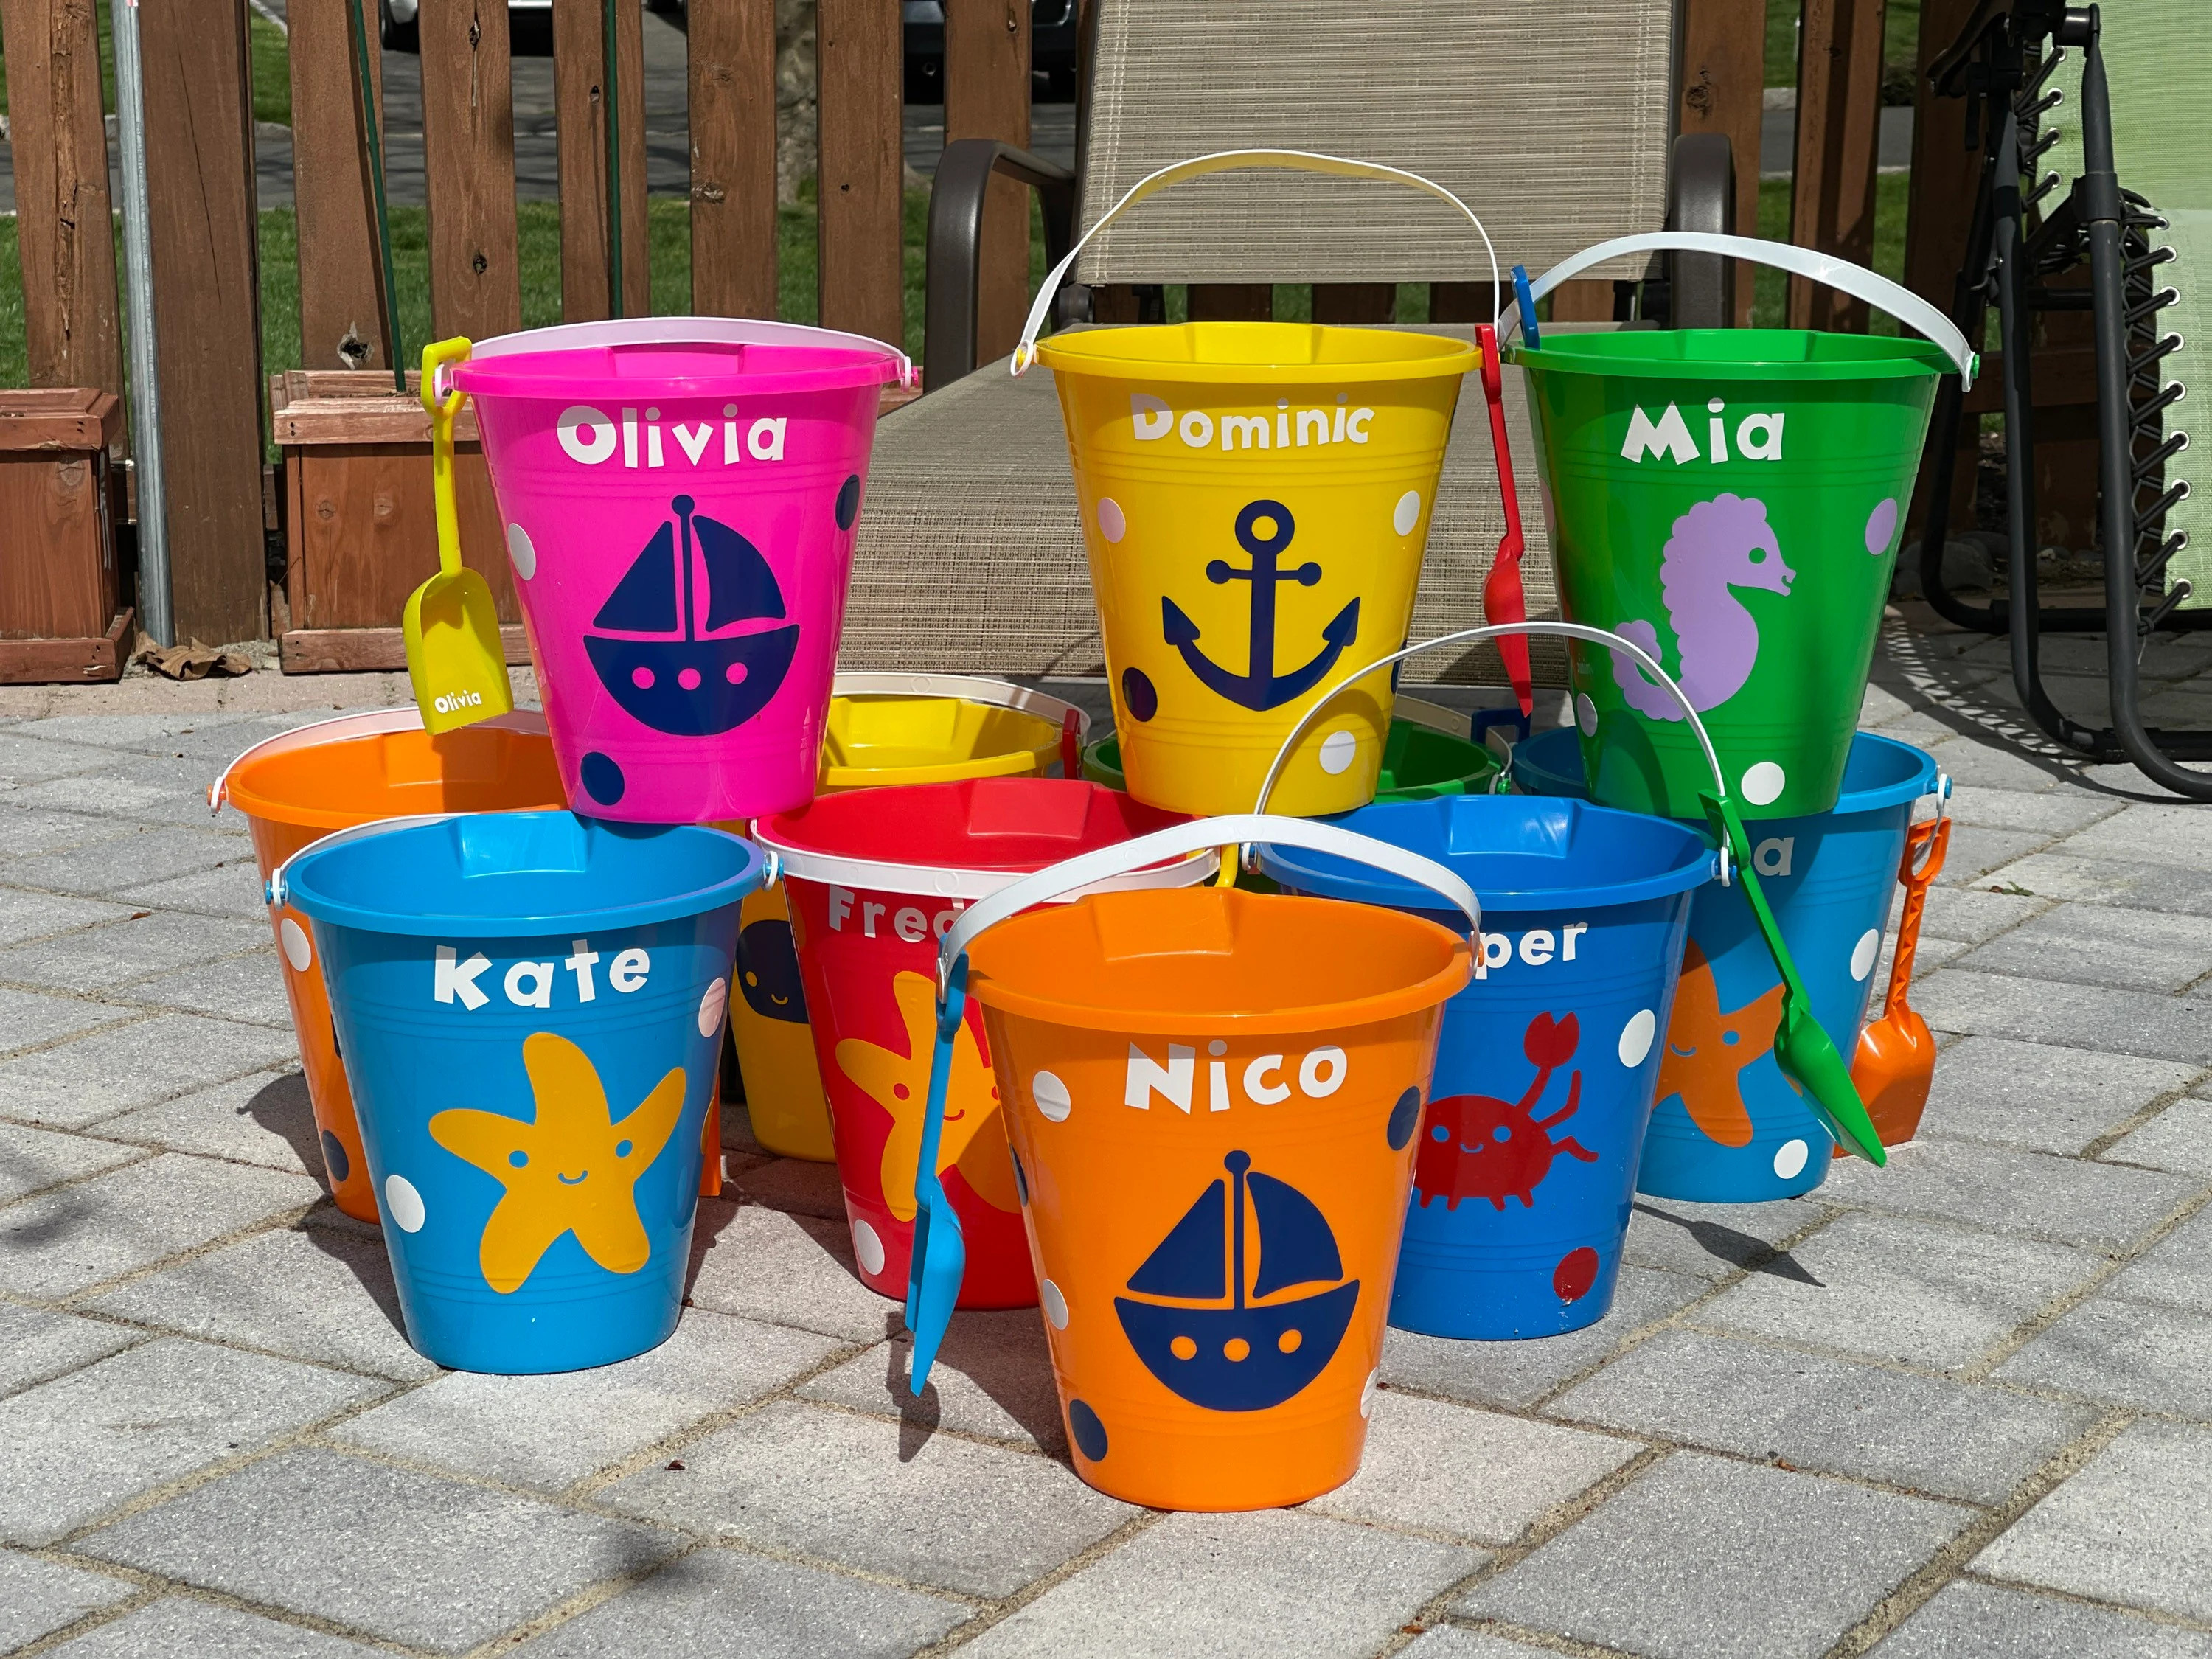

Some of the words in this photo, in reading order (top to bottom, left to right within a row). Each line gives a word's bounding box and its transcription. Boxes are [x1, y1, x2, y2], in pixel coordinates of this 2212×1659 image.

[557, 403, 787, 468] Olivia
[1130, 392, 1375, 451] Dominic
[1620, 397, 1785, 465] Mia
[434, 689, 482, 714] Olivia
[434, 939, 650, 1011] Kate
[1124, 1039, 1348, 1115] Nico
